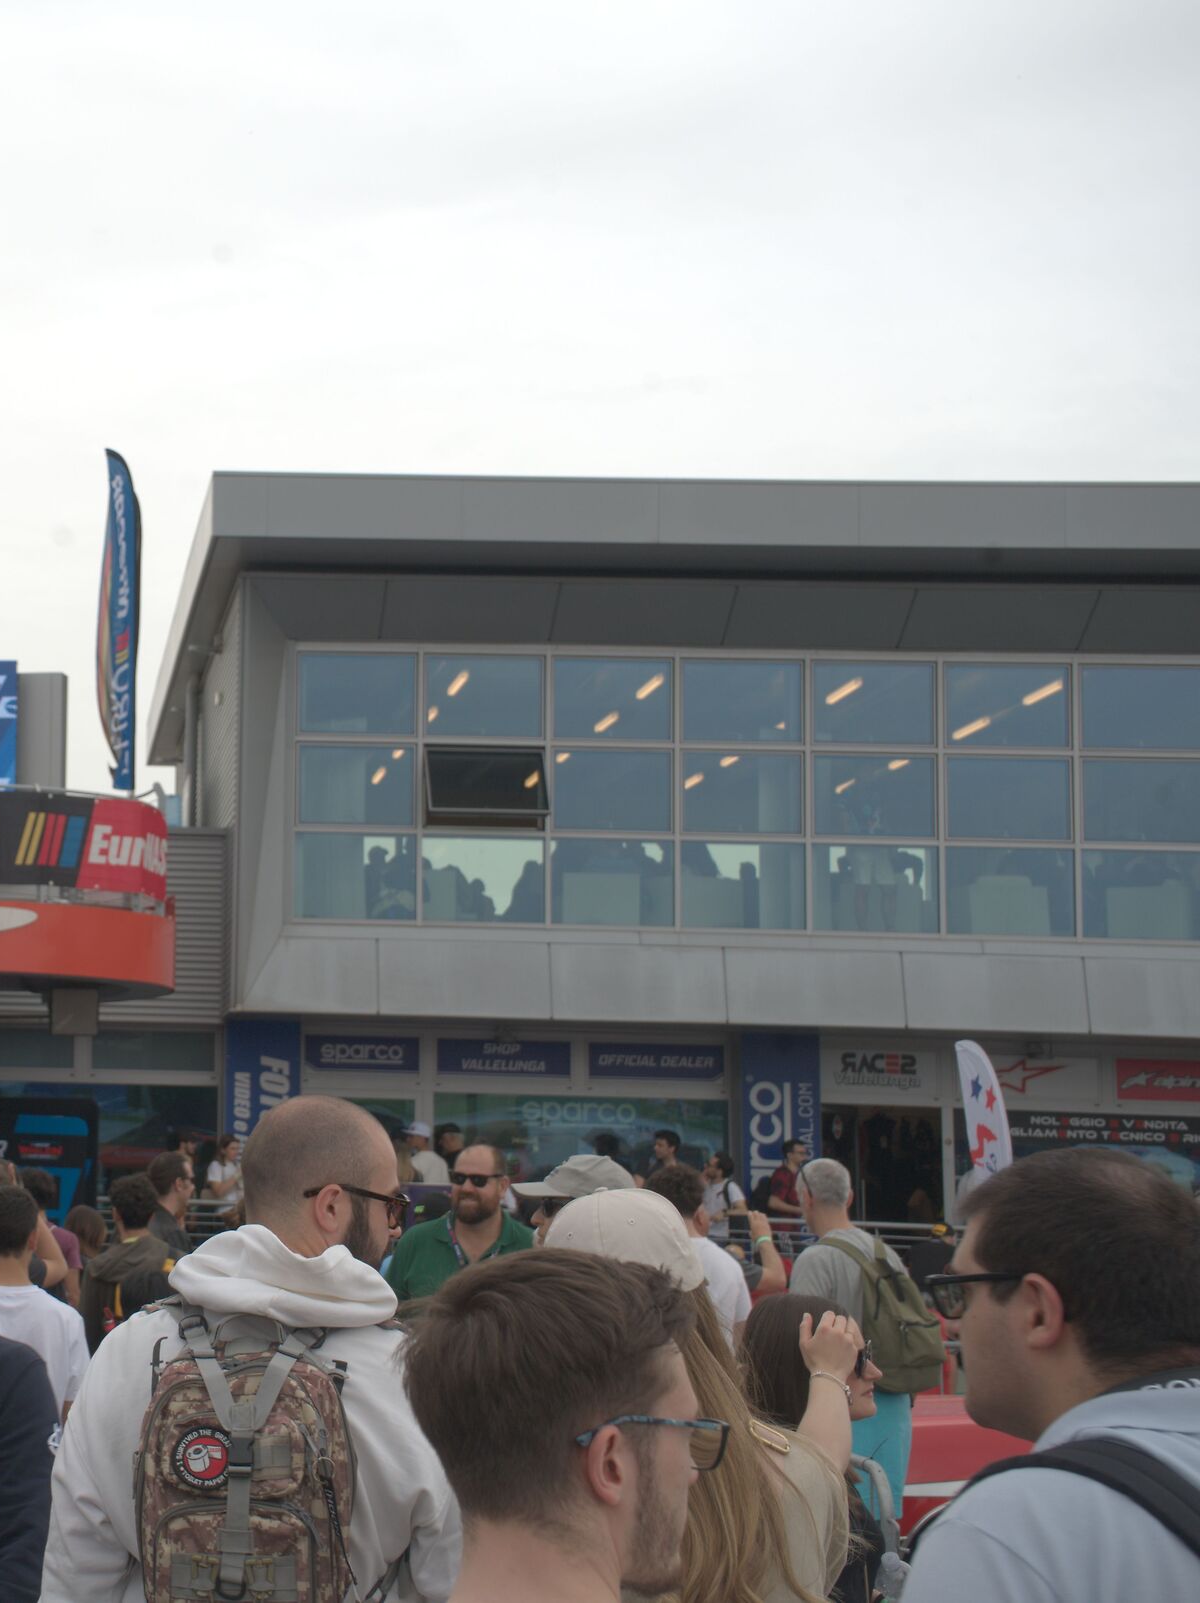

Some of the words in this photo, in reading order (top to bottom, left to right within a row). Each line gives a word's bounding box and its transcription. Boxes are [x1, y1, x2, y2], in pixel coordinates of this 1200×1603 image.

[321, 1043, 404, 1063] sparco
[483, 1043, 520, 1055] SHOP
[461, 1059, 547, 1073] VALLELUNGA
[598, 1054, 657, 1067] OFFICIAL
[660, 1055, 715, 1068] DEALER
[834, 1071, 921, 1091] Vallelunga
[233, 1072, 251, 1119] VIDEO
[522, 1101, 636, 1125] sparco
